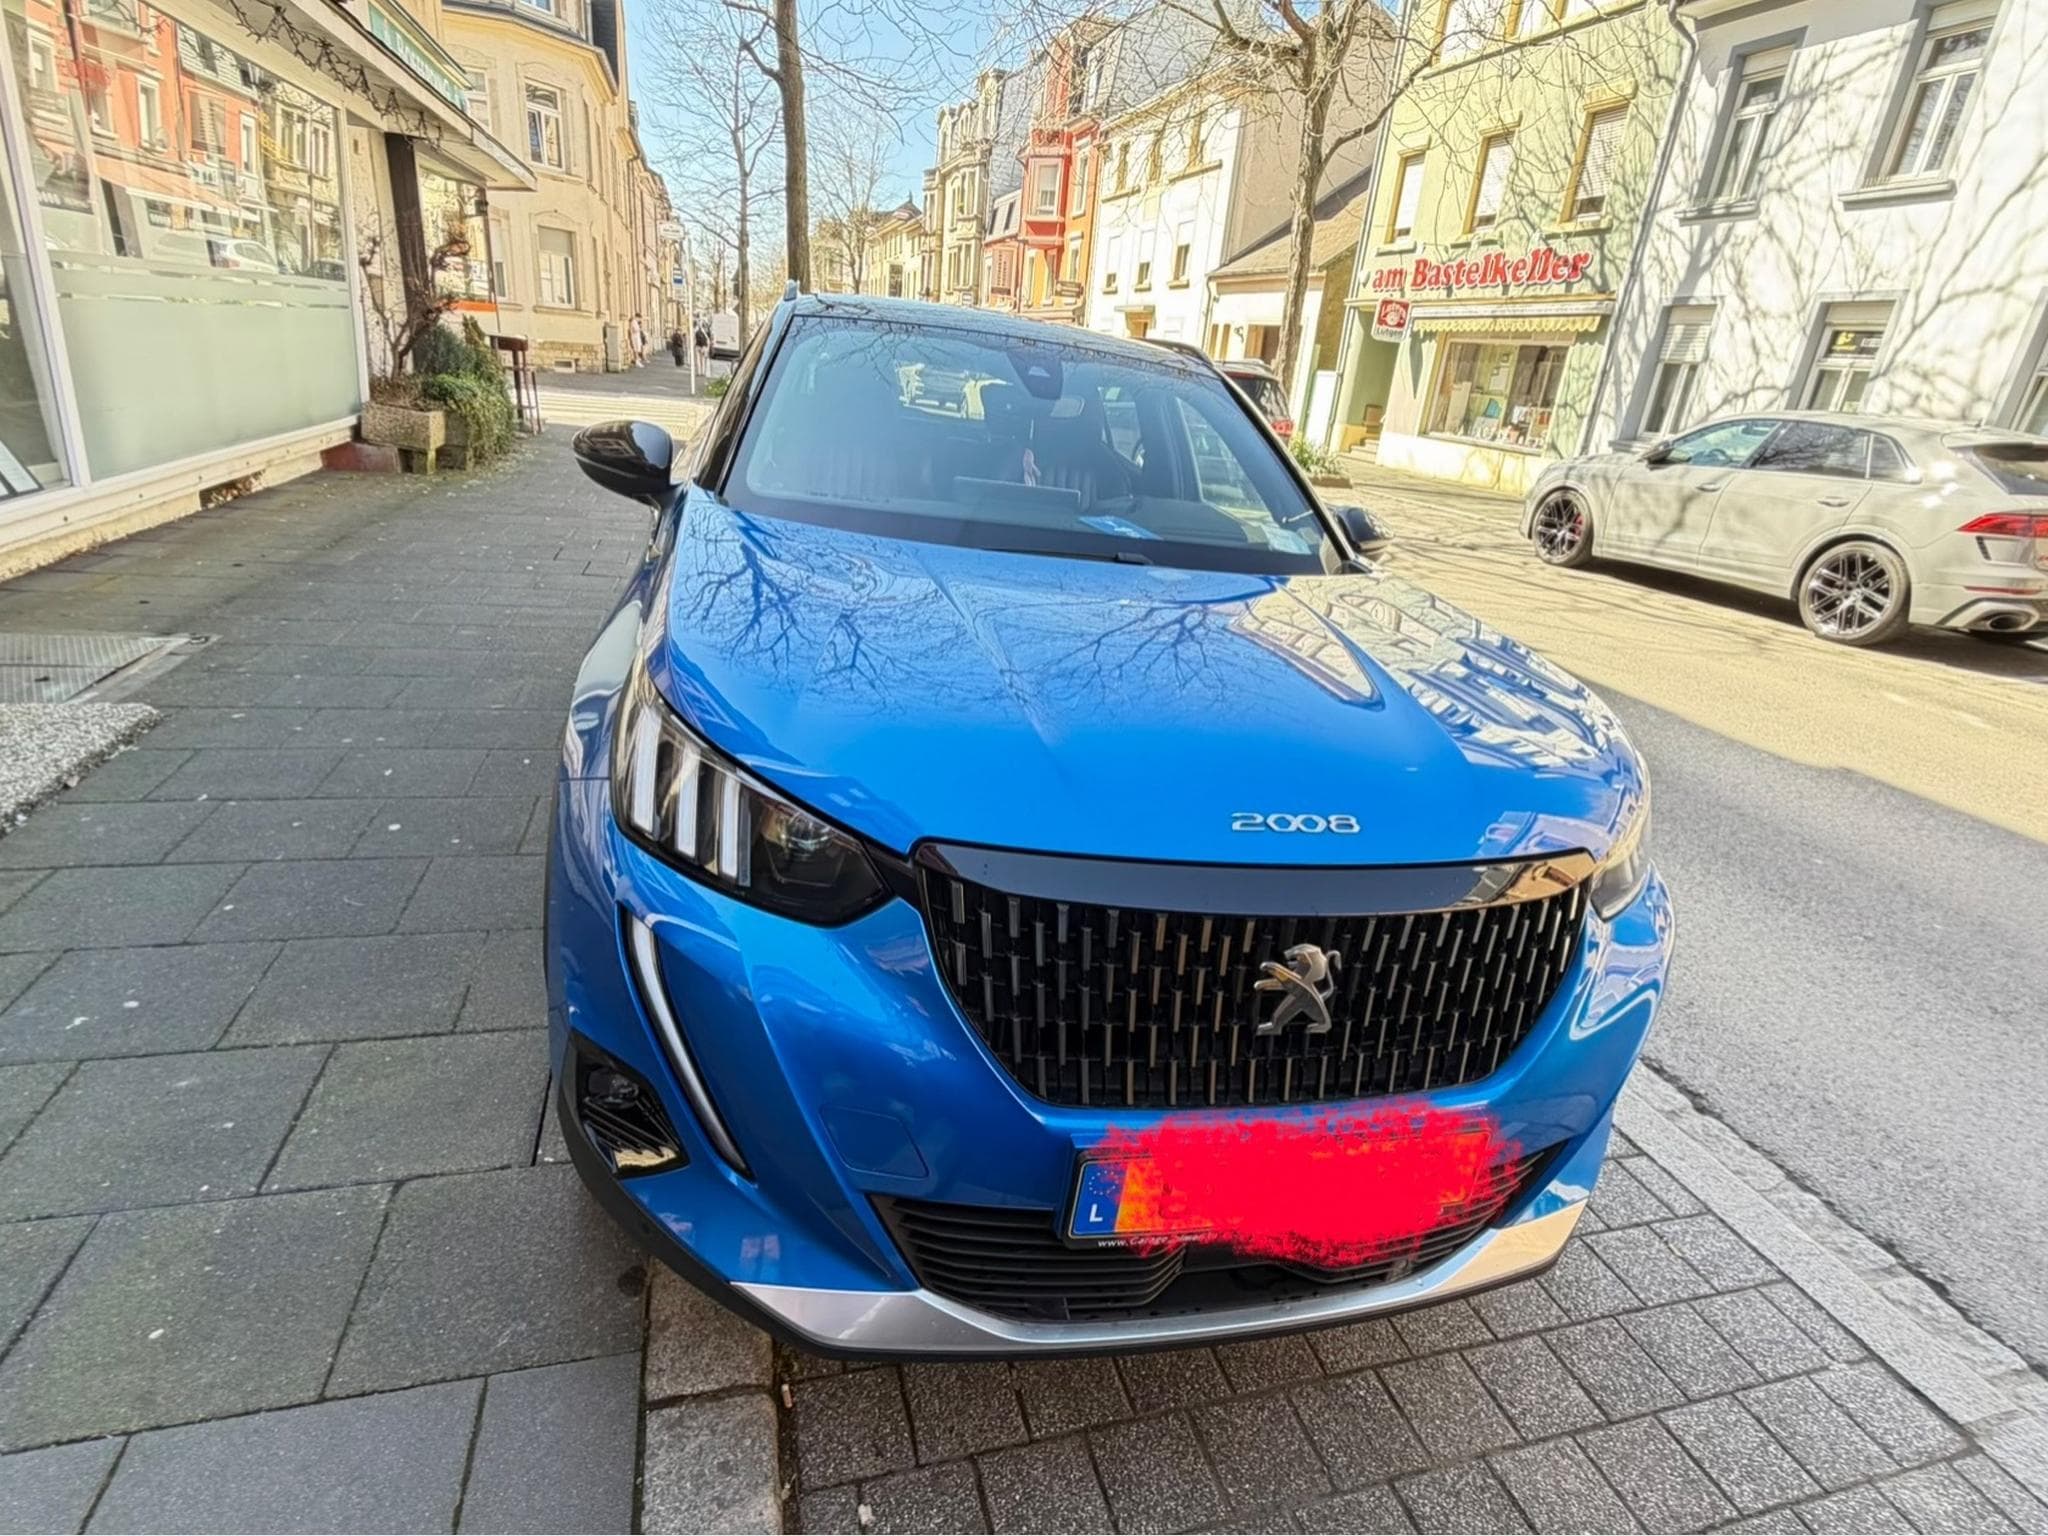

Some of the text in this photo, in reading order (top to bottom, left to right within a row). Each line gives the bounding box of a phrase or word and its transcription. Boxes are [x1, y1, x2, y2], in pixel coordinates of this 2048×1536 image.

[1372, 247, 1591, 290] am Bastelkeller
[1232, 812, 1360, 833] 2008
[1089, 1203, 1103, 1222] L
